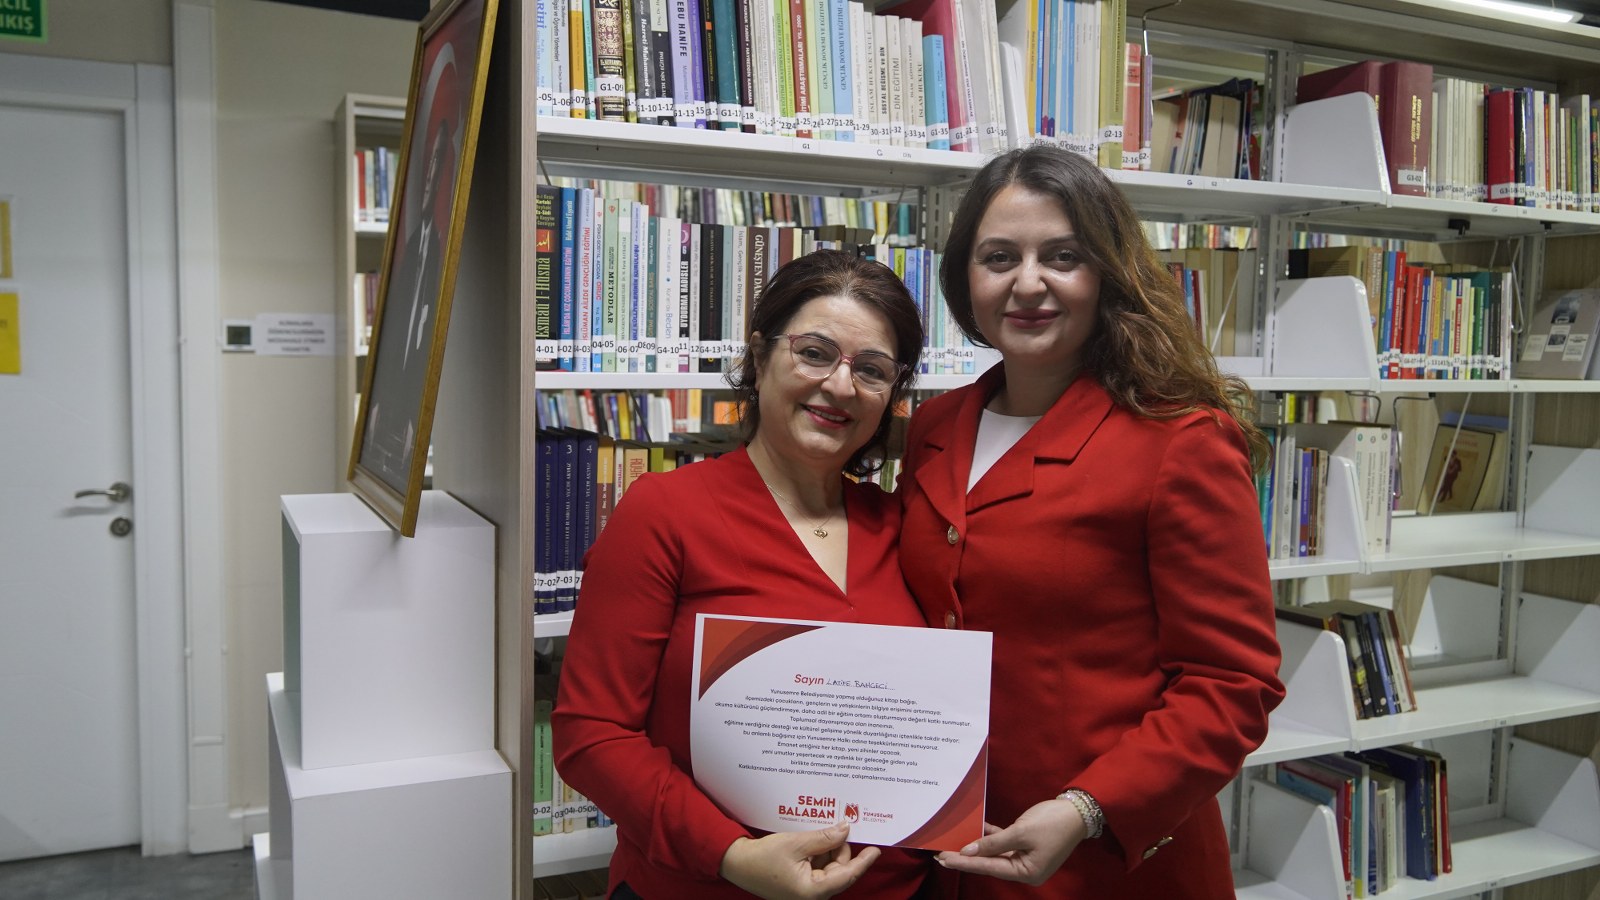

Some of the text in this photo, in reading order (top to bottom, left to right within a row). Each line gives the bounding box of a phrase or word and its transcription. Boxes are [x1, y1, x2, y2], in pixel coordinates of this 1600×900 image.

[679, 24, 687, 57] HANİFE
[892, 58, 900, 91] EĞİTİMİ
[931, 128, 949, 136] G1-35
[581, 227, 590, 250] EĞİTİMİ
[753, 235, 764, 276] GÜNEŞTEN
[581, 252, 590, 287] GENÇLİĞİN
[566, 444, 573, 453] 3
[794, 674, 824, 686] Sayın
[778, 805, 835, 819] BALABAN
